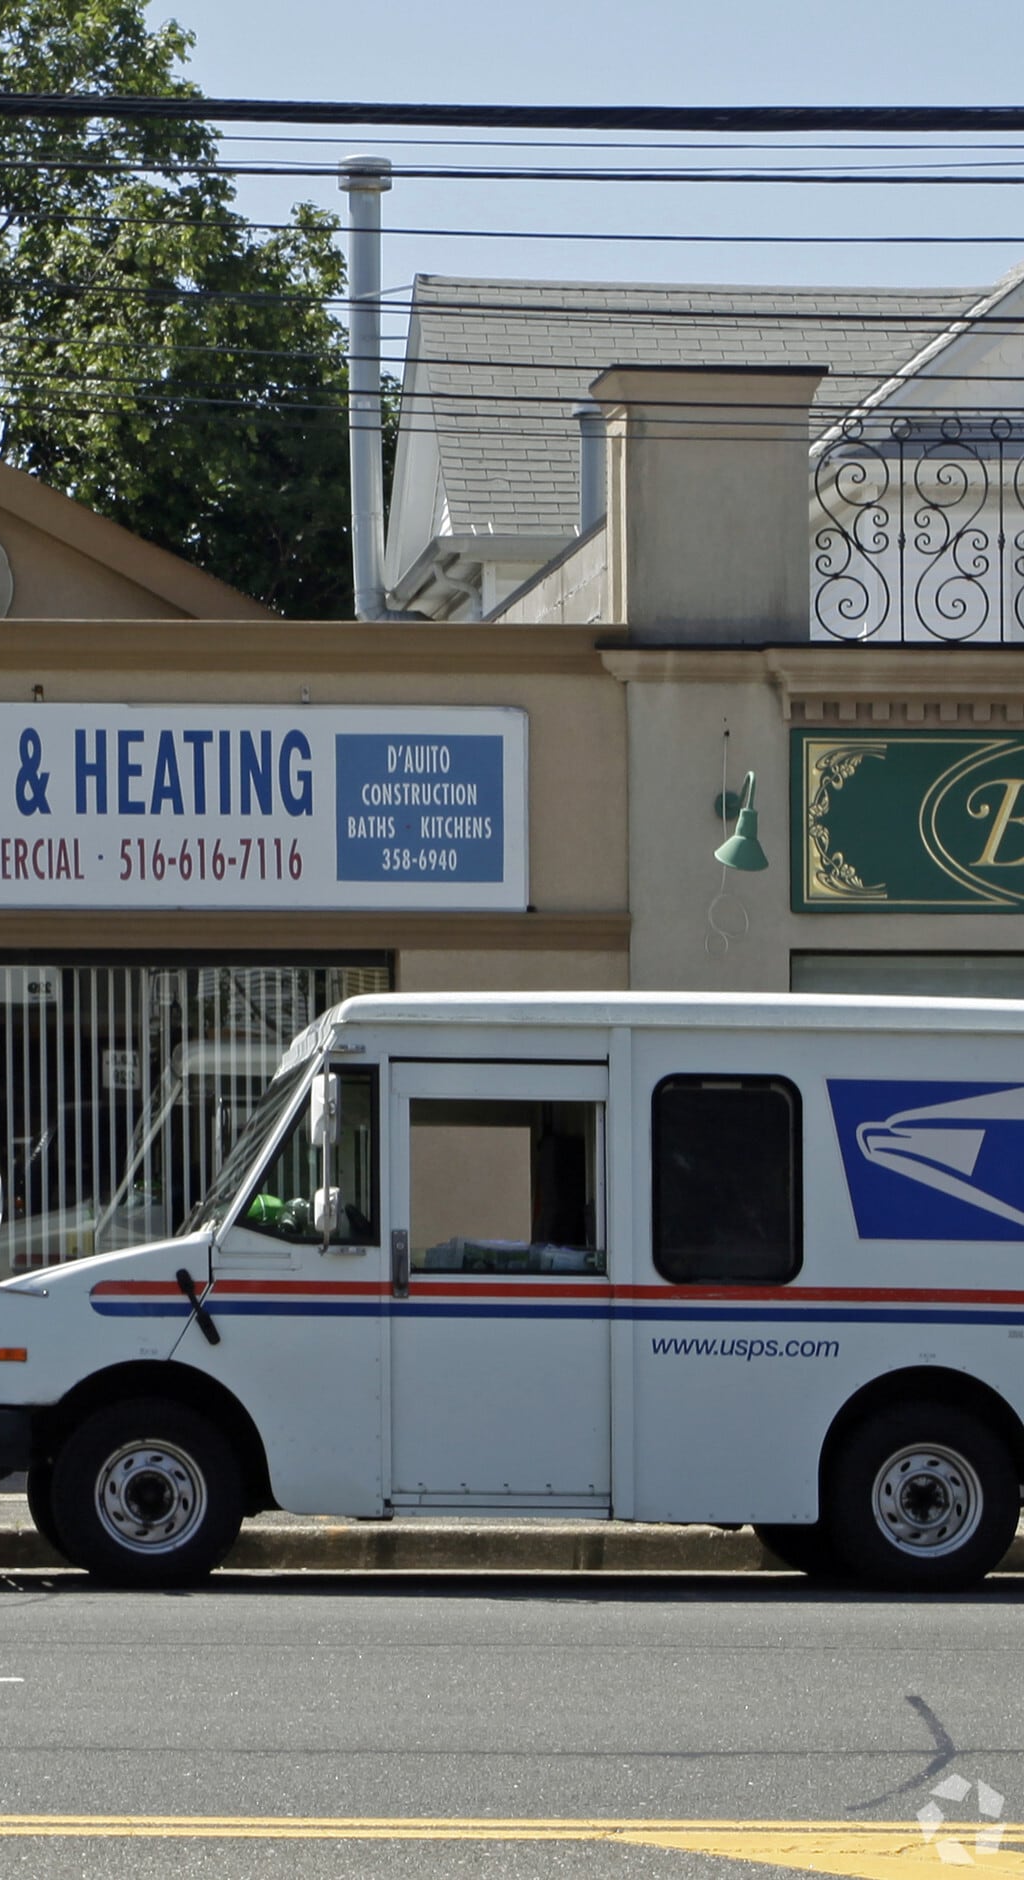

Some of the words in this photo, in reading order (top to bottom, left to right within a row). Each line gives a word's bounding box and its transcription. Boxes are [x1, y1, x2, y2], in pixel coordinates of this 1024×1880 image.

[14, 726, 53, 818] &
[74, 727, 314, 818] HEATING
[387, 745, 451, 774] D'AUITO
[361, 783, 478, 806] CONSTRUCTION
[347, 816, 396, 839] BATHS
[420, 816, 493, 839] KITCHENS
[119, 837, 303, 882] 516-616-7116
[382, 848, 458, 871] 358-6940
[651, 1336, 840, 1363] www.usps.com
